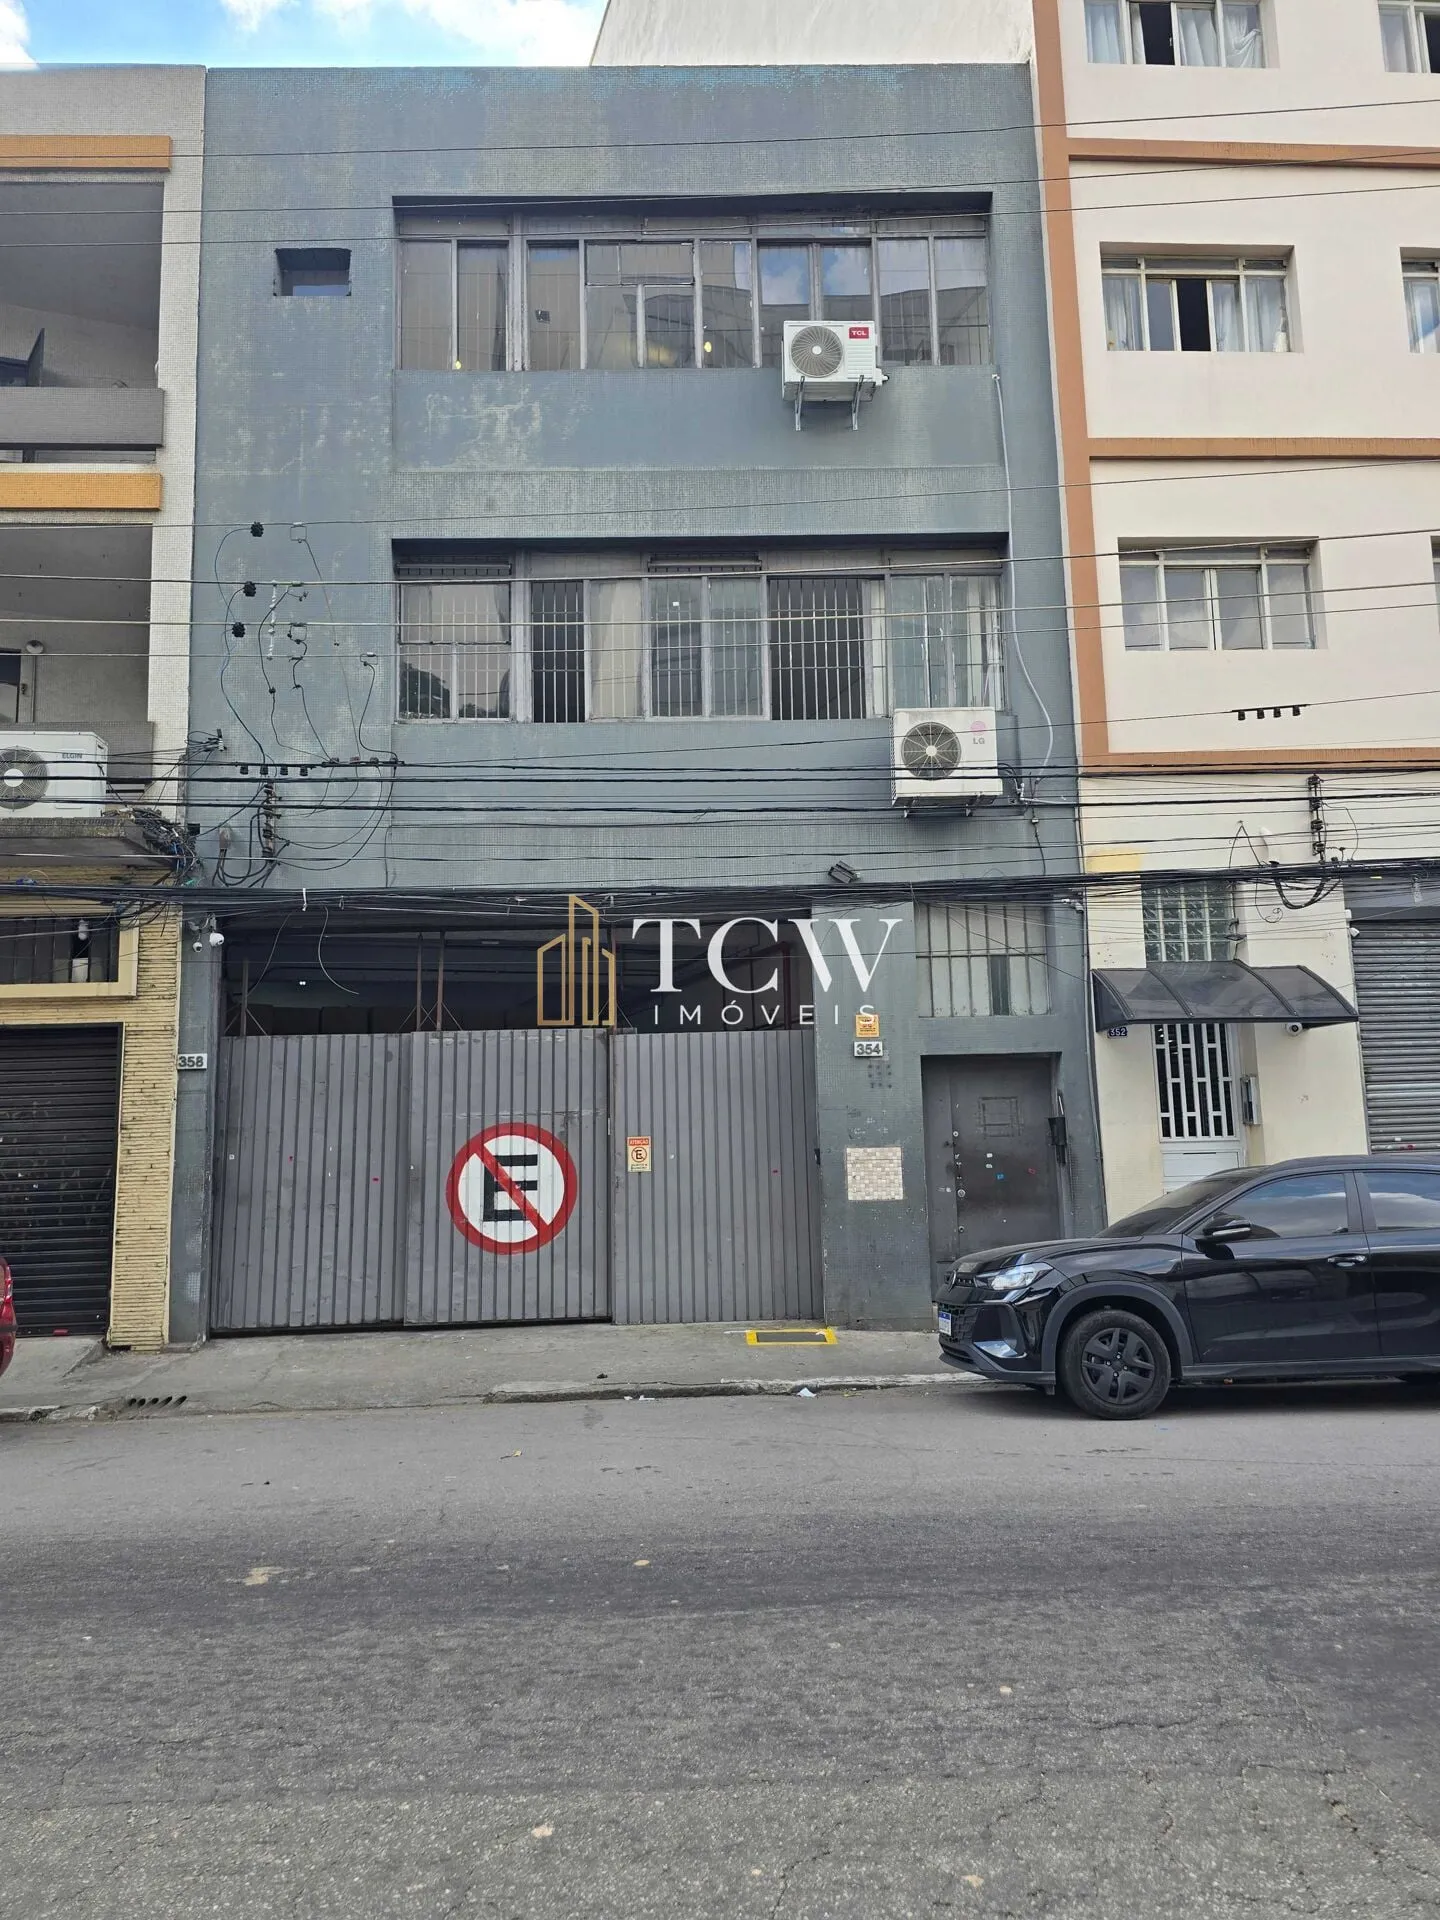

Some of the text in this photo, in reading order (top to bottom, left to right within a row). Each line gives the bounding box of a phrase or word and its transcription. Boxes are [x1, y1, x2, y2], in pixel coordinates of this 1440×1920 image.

[972, 737, 985, 745] LG
[1110, 1027, 1126, 1036] 352
[856, 1043, 881, 1055] 354
[178, 1055, 204, 1068] 358
[482, 1154, 538, 1222] E
